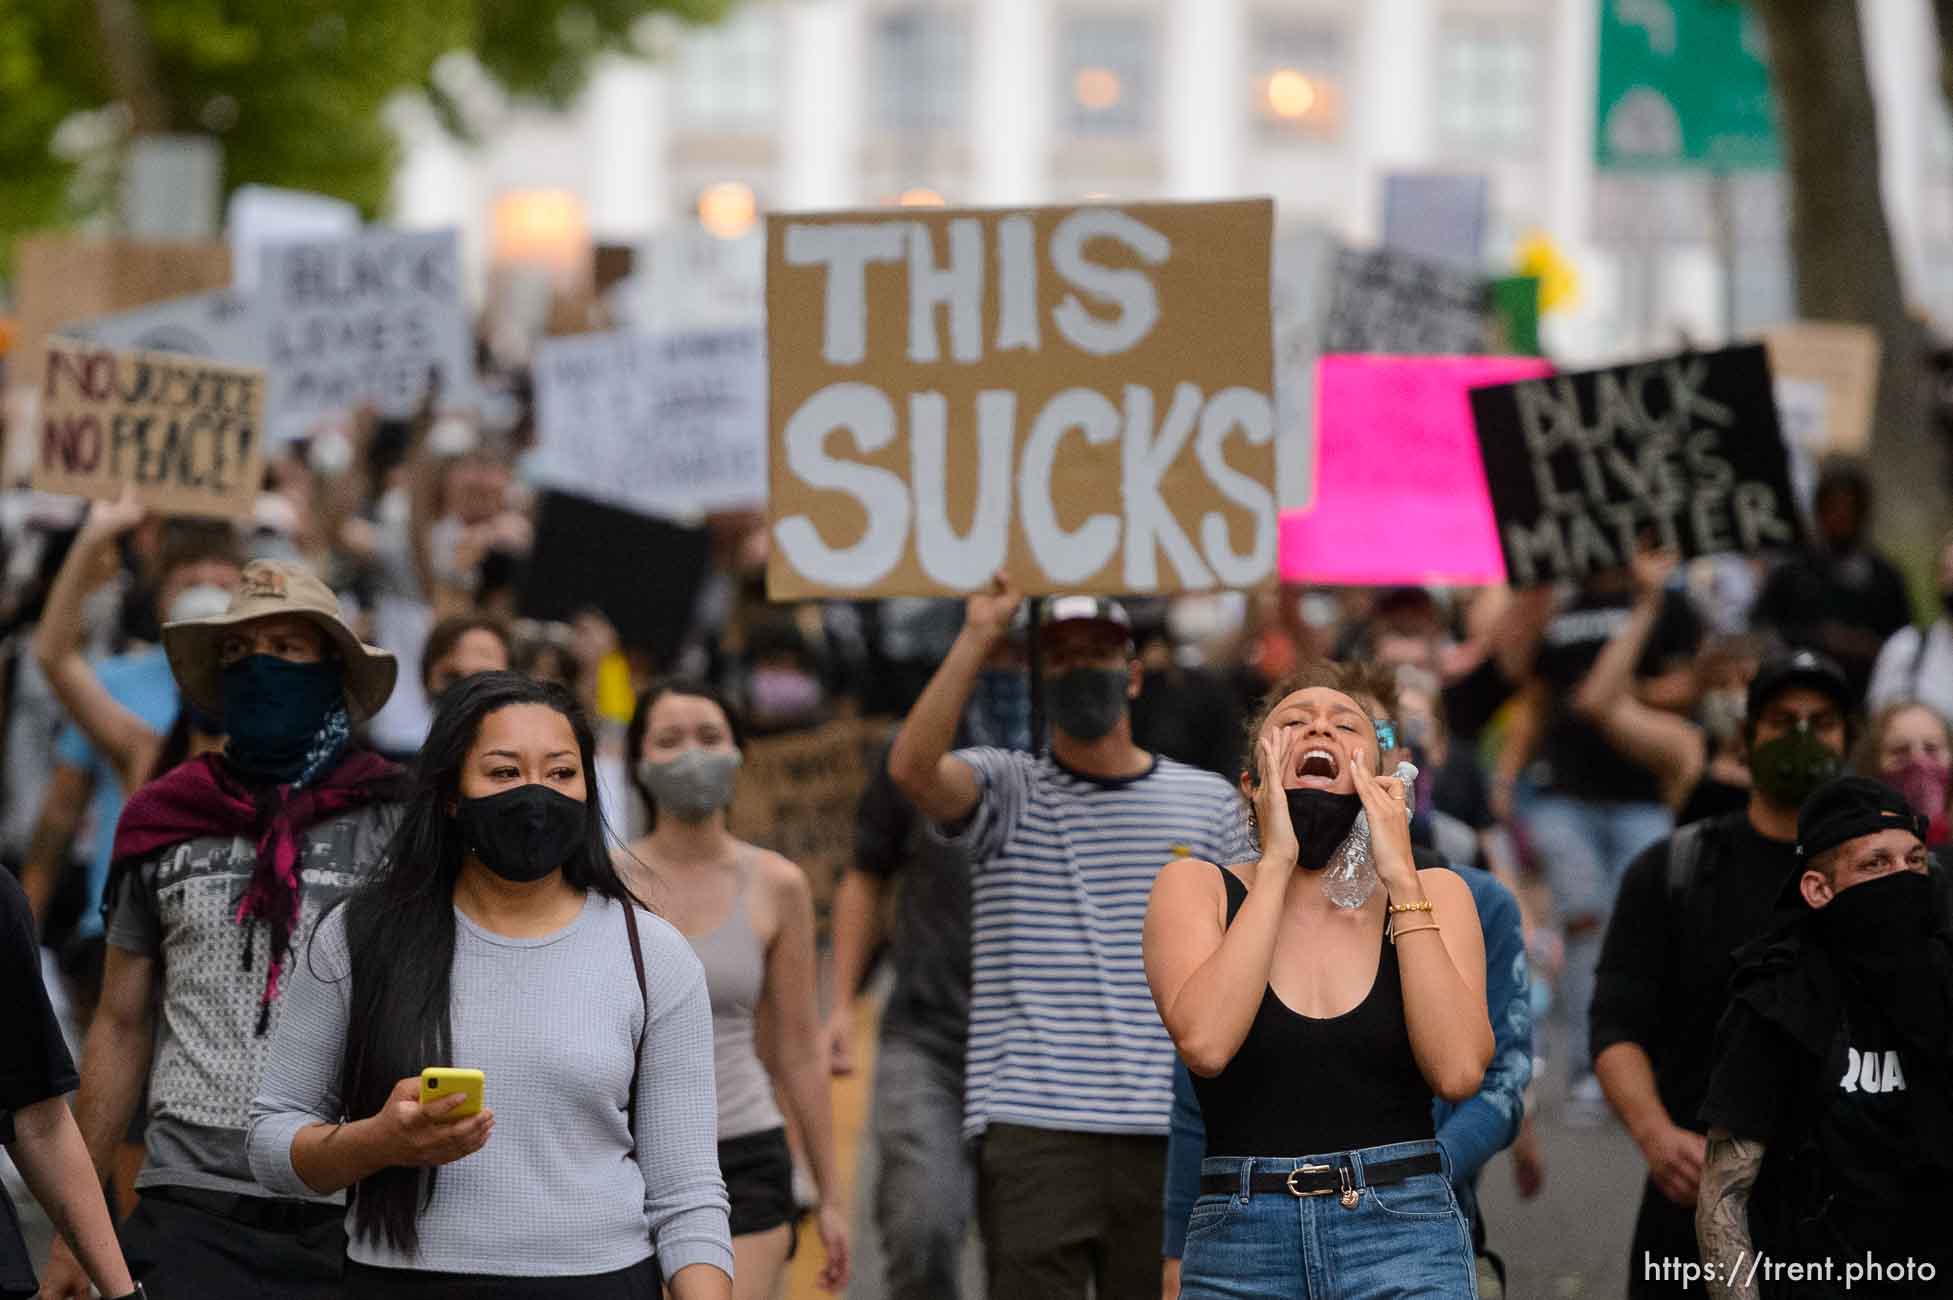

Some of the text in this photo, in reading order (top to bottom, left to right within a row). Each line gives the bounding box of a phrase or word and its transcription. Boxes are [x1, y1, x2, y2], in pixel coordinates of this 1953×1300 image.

[785, 206, 1171, 364] THIS
[44, 349, 118, 402] NO
[1514, 357, 1734, 447] BLACK
[42, 413, 102, 476] NO
[773, 381, 1277, 591] SUCKS
[1530, 428, 1735, 517] LIVES
[1505, 483, 1792, 586] MATTER
